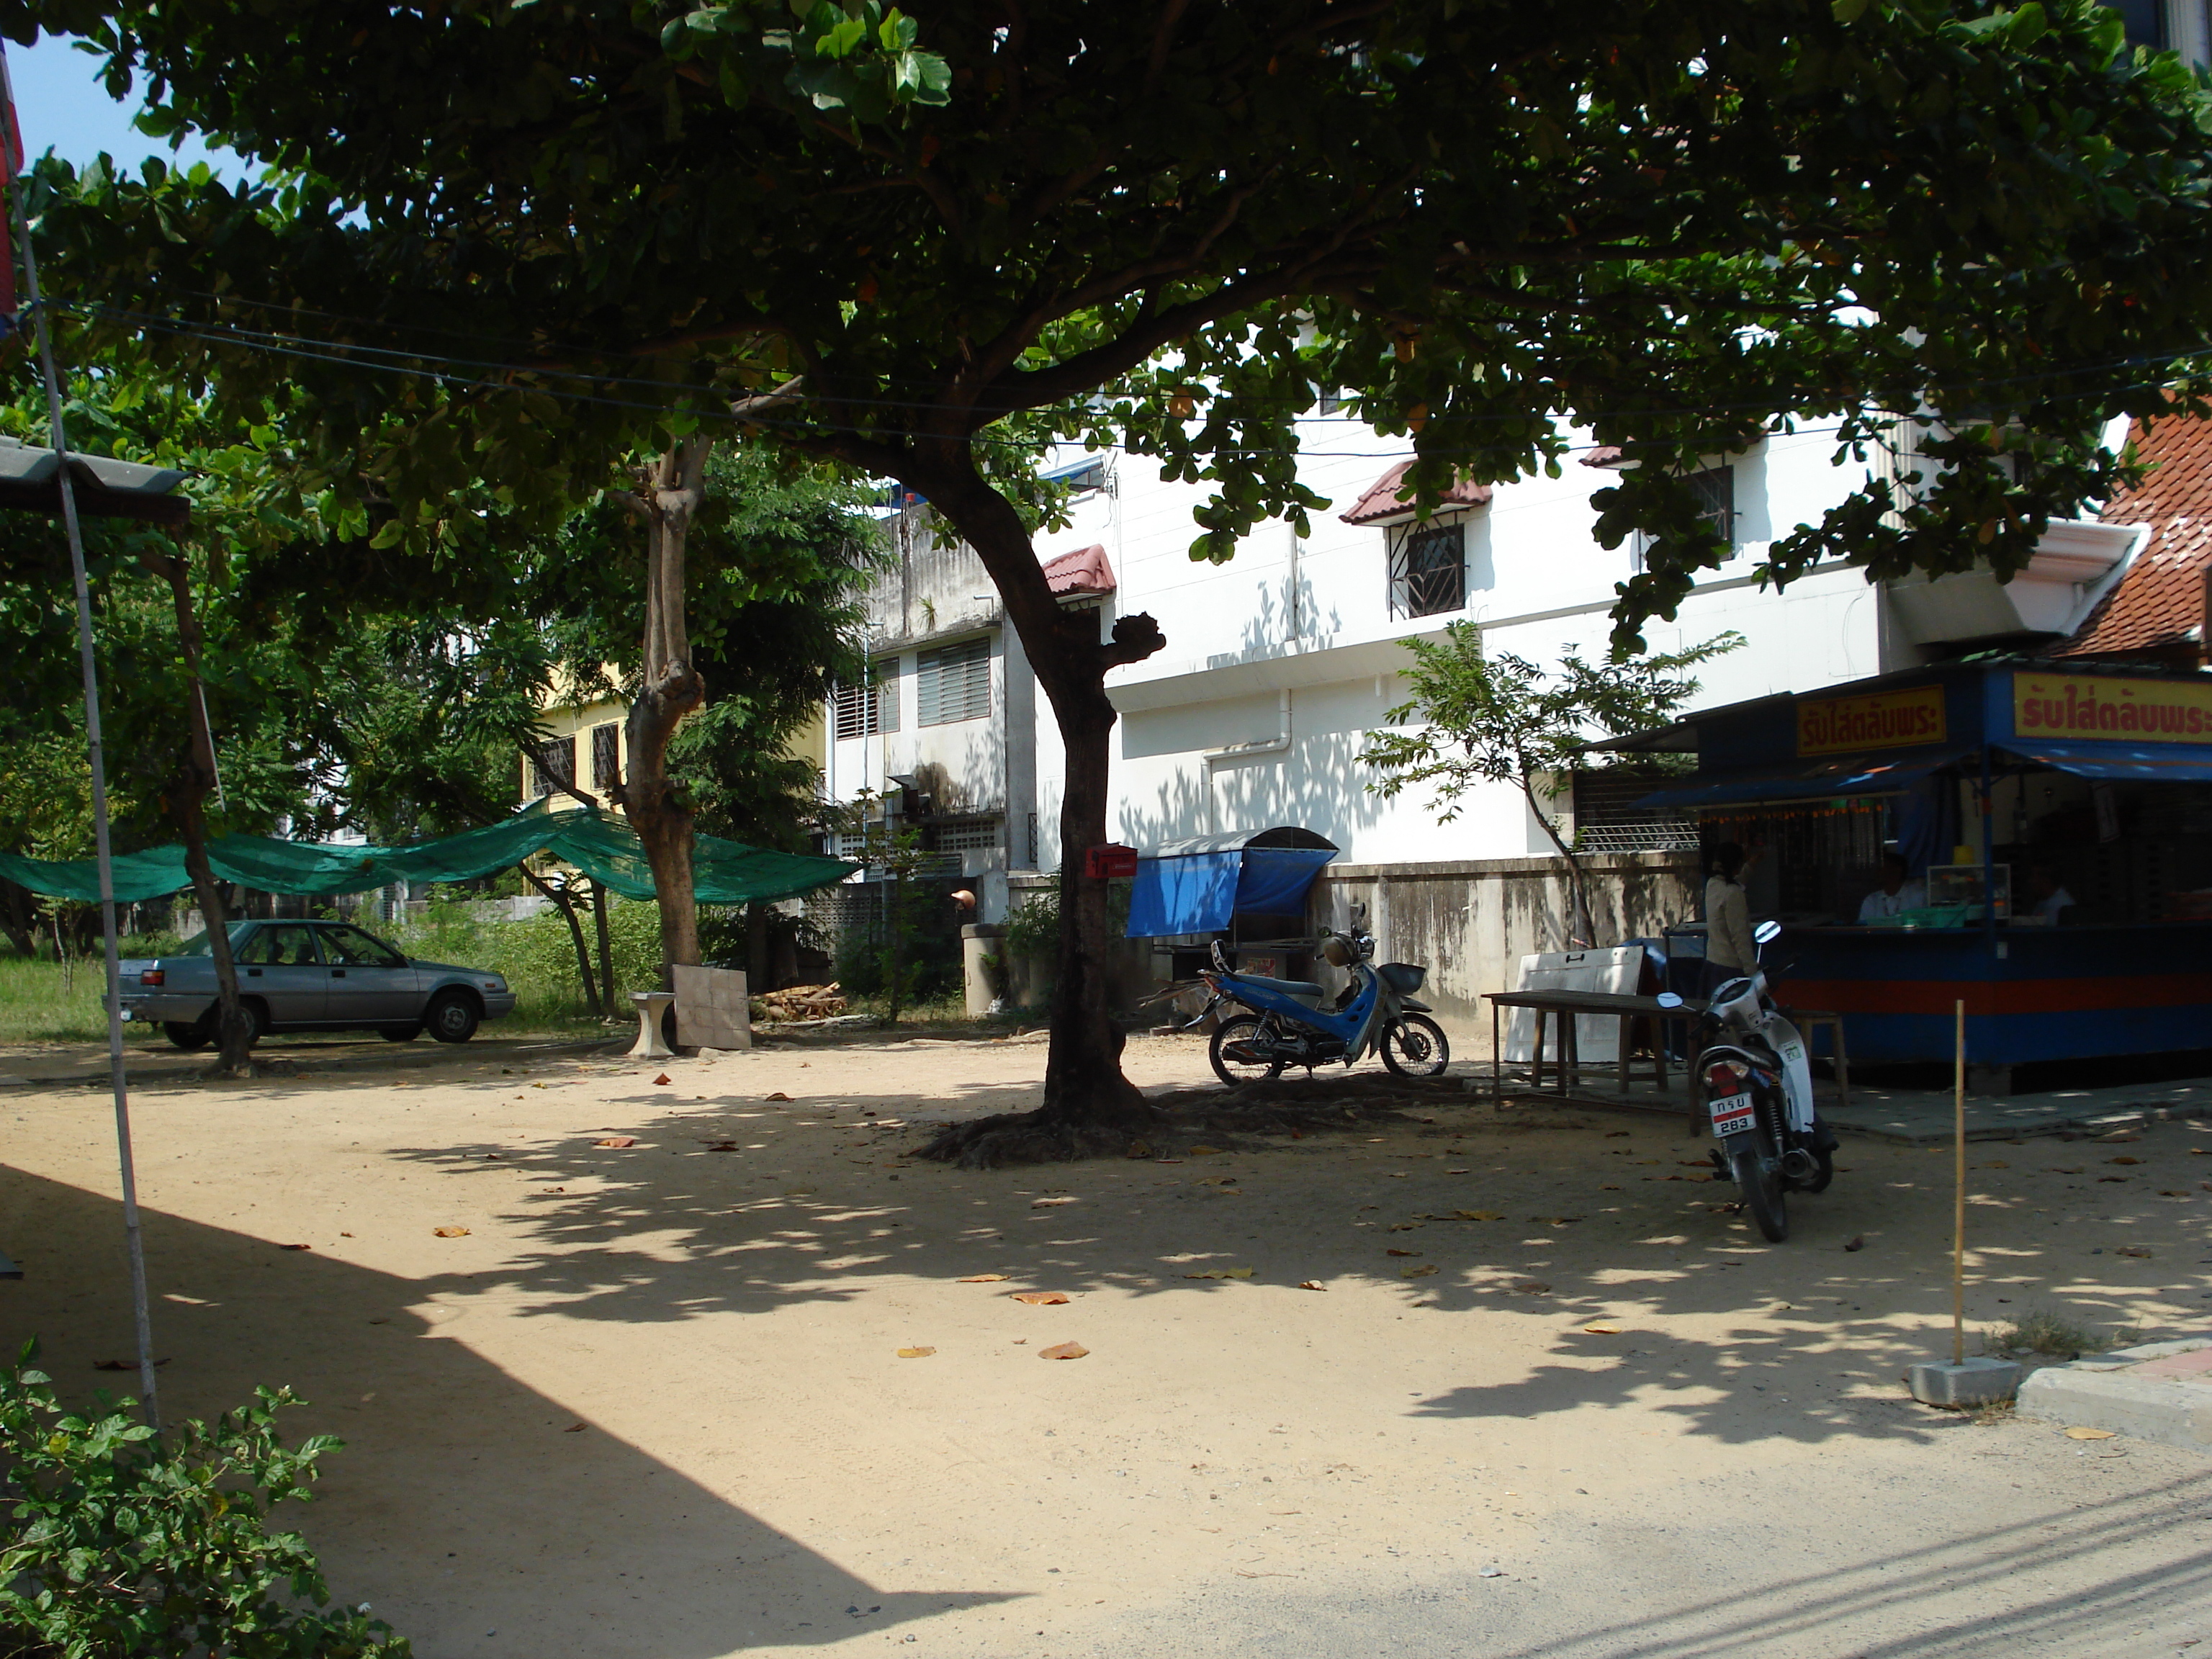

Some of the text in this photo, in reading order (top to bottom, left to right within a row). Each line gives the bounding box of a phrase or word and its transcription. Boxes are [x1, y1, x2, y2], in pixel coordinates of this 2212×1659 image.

[1803, 701, 1937, 747] รับใส่ตลับพระ
[1720, 1118, 1748, 1133] 283
